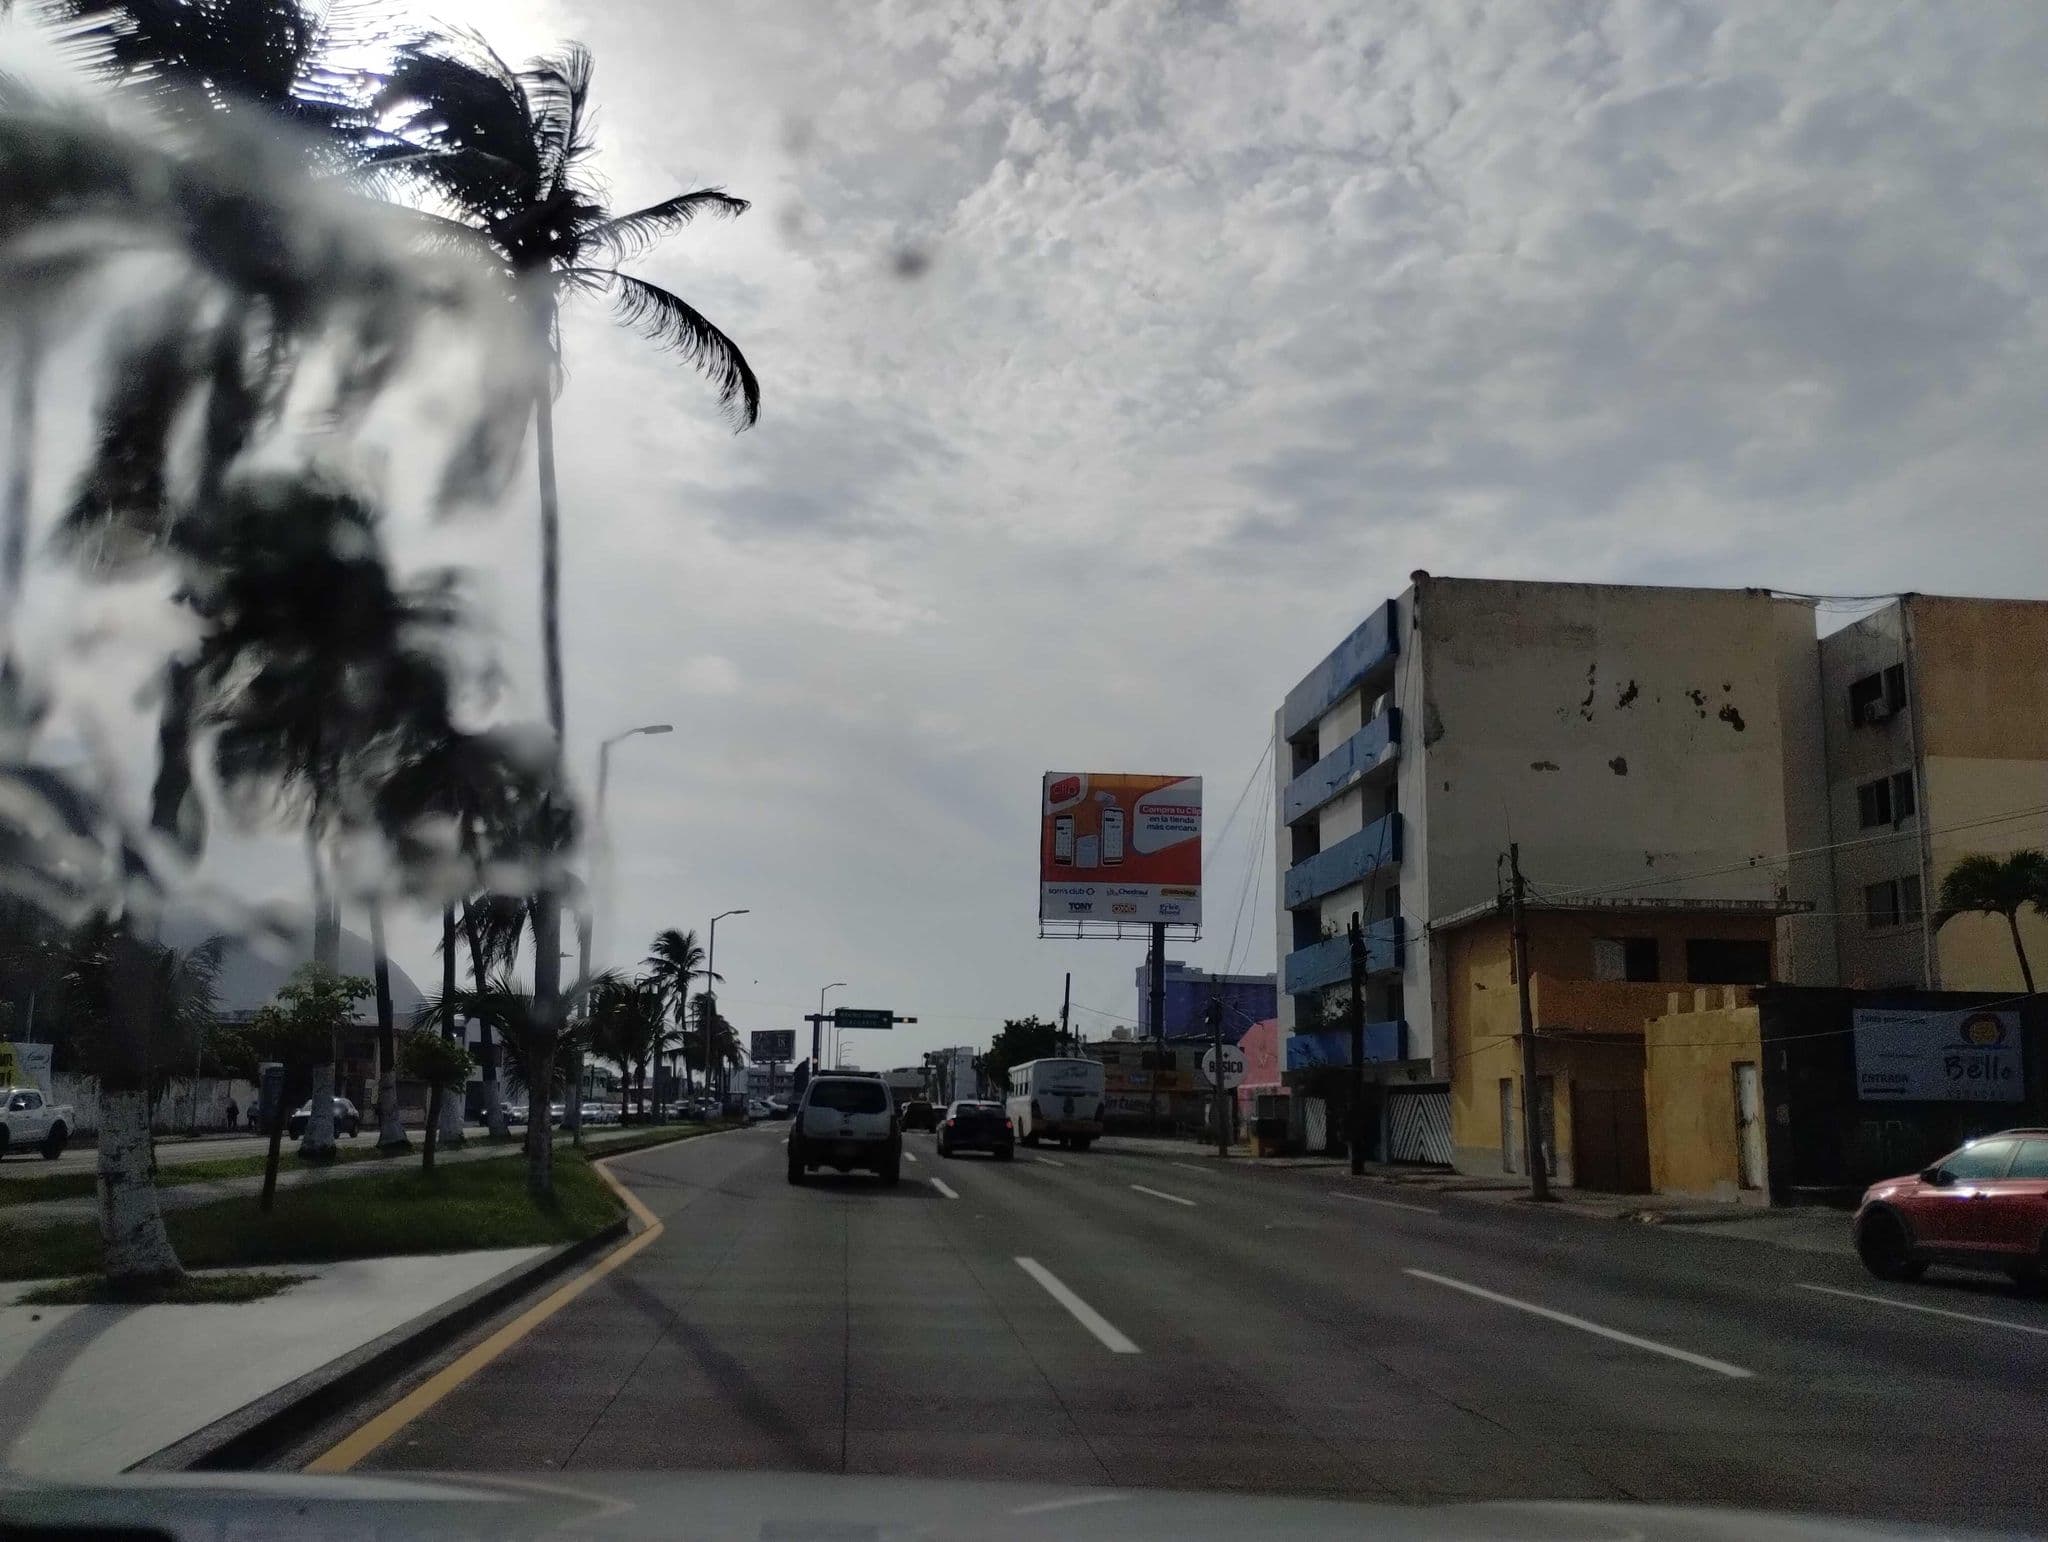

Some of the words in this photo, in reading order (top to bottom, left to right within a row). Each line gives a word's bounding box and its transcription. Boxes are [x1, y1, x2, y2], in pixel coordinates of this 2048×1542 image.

[1142, 805, 1175, 815] Compra
[1169, 816, 1195, 824] tienda
[1068, 902, 1093, 910] TONY
[1209, 1060, 1243, 1073] BSICO
[1861, 1073, 1909, 1083] ENTRADA
